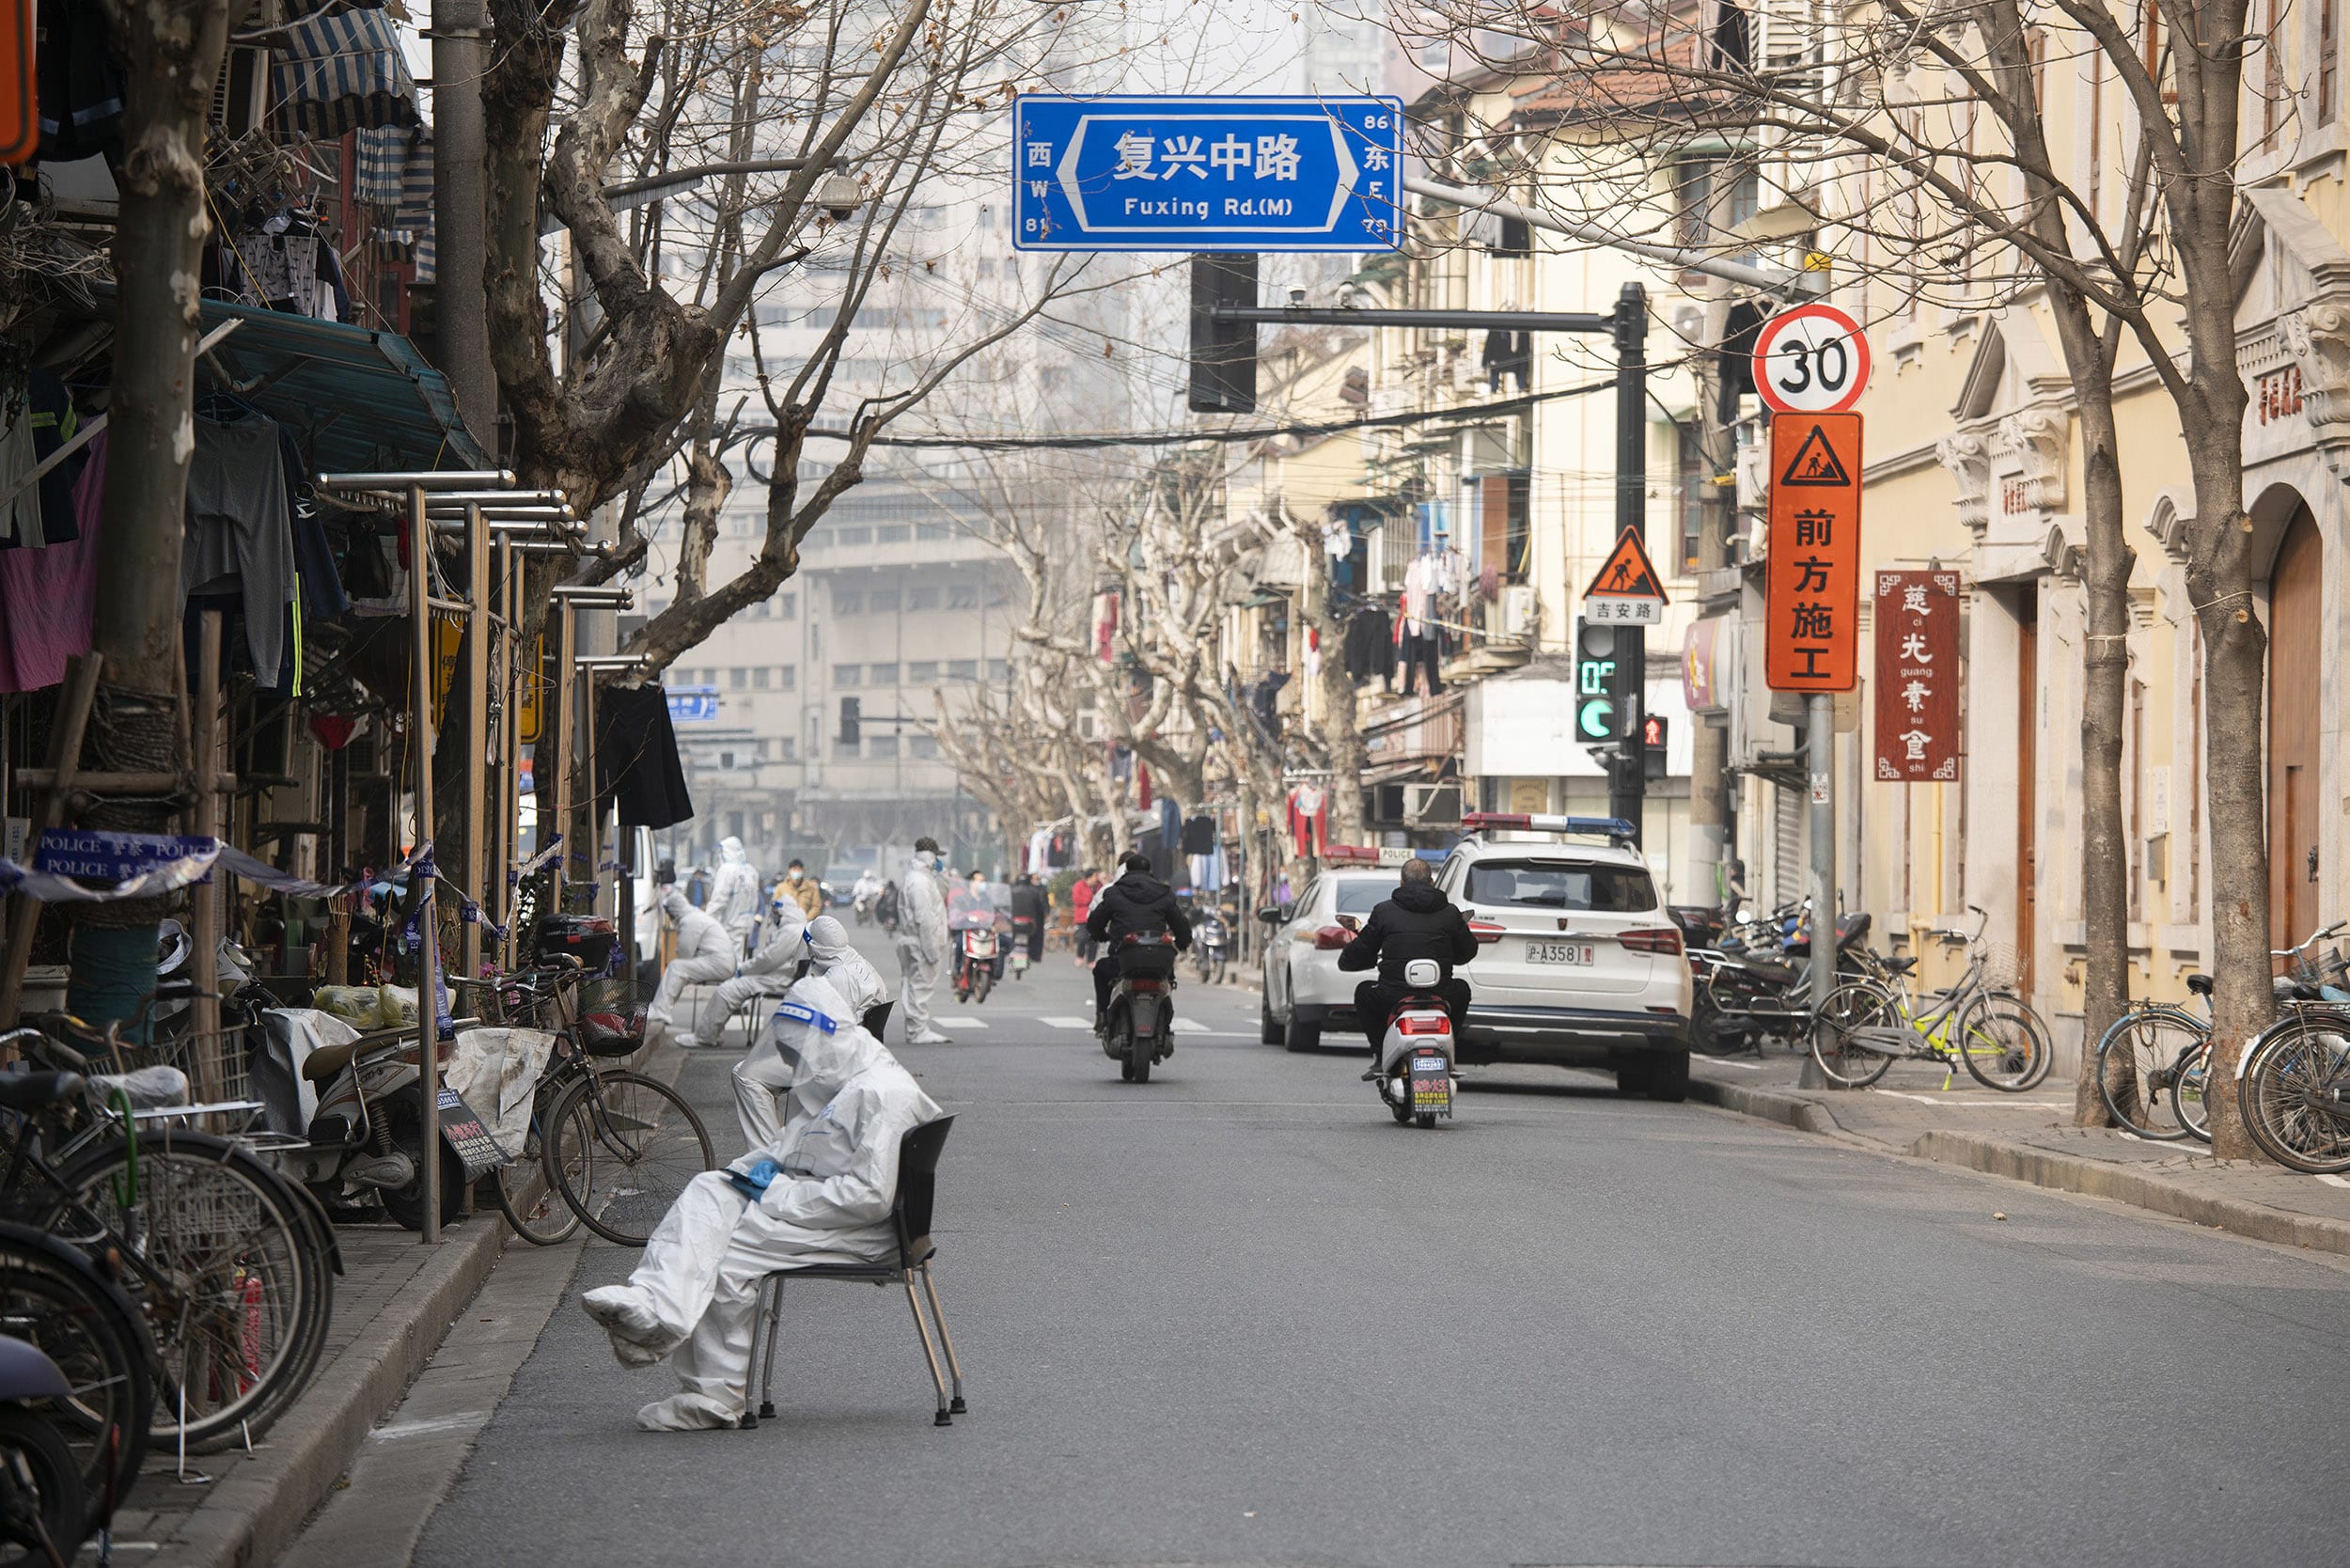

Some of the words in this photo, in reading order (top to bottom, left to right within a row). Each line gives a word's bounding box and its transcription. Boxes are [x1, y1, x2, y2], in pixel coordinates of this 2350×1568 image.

[1363, 115, 1388, 131] 86
[1026, 141, 1052, 168] 西
[1113, 133, 1302, 181] 复兴中路
[1363, 145, 1390, 172] 东
[1030, 180, 1049, 198] W
[1368, 180, 1384, 199] E
[1124, 197, 1209, 220] Fuxing
[1224, 197, 1293, 217] Rd.(M)
[1779, 337, 1847, 394] 30
[1790, 509, 1836, 679] 前方施工
[1596, 603, 1651, 619] 吉安路
[1913, 619, 1922, 627] ci
[1900, 667, 1934, 678] guang
[1909, 763, 1924, 773] shi
[41, 836, 102, 854] POLICE
[1382, 849, 1411, 859] POLICE
[48, 859, 108, 877] POLICE
